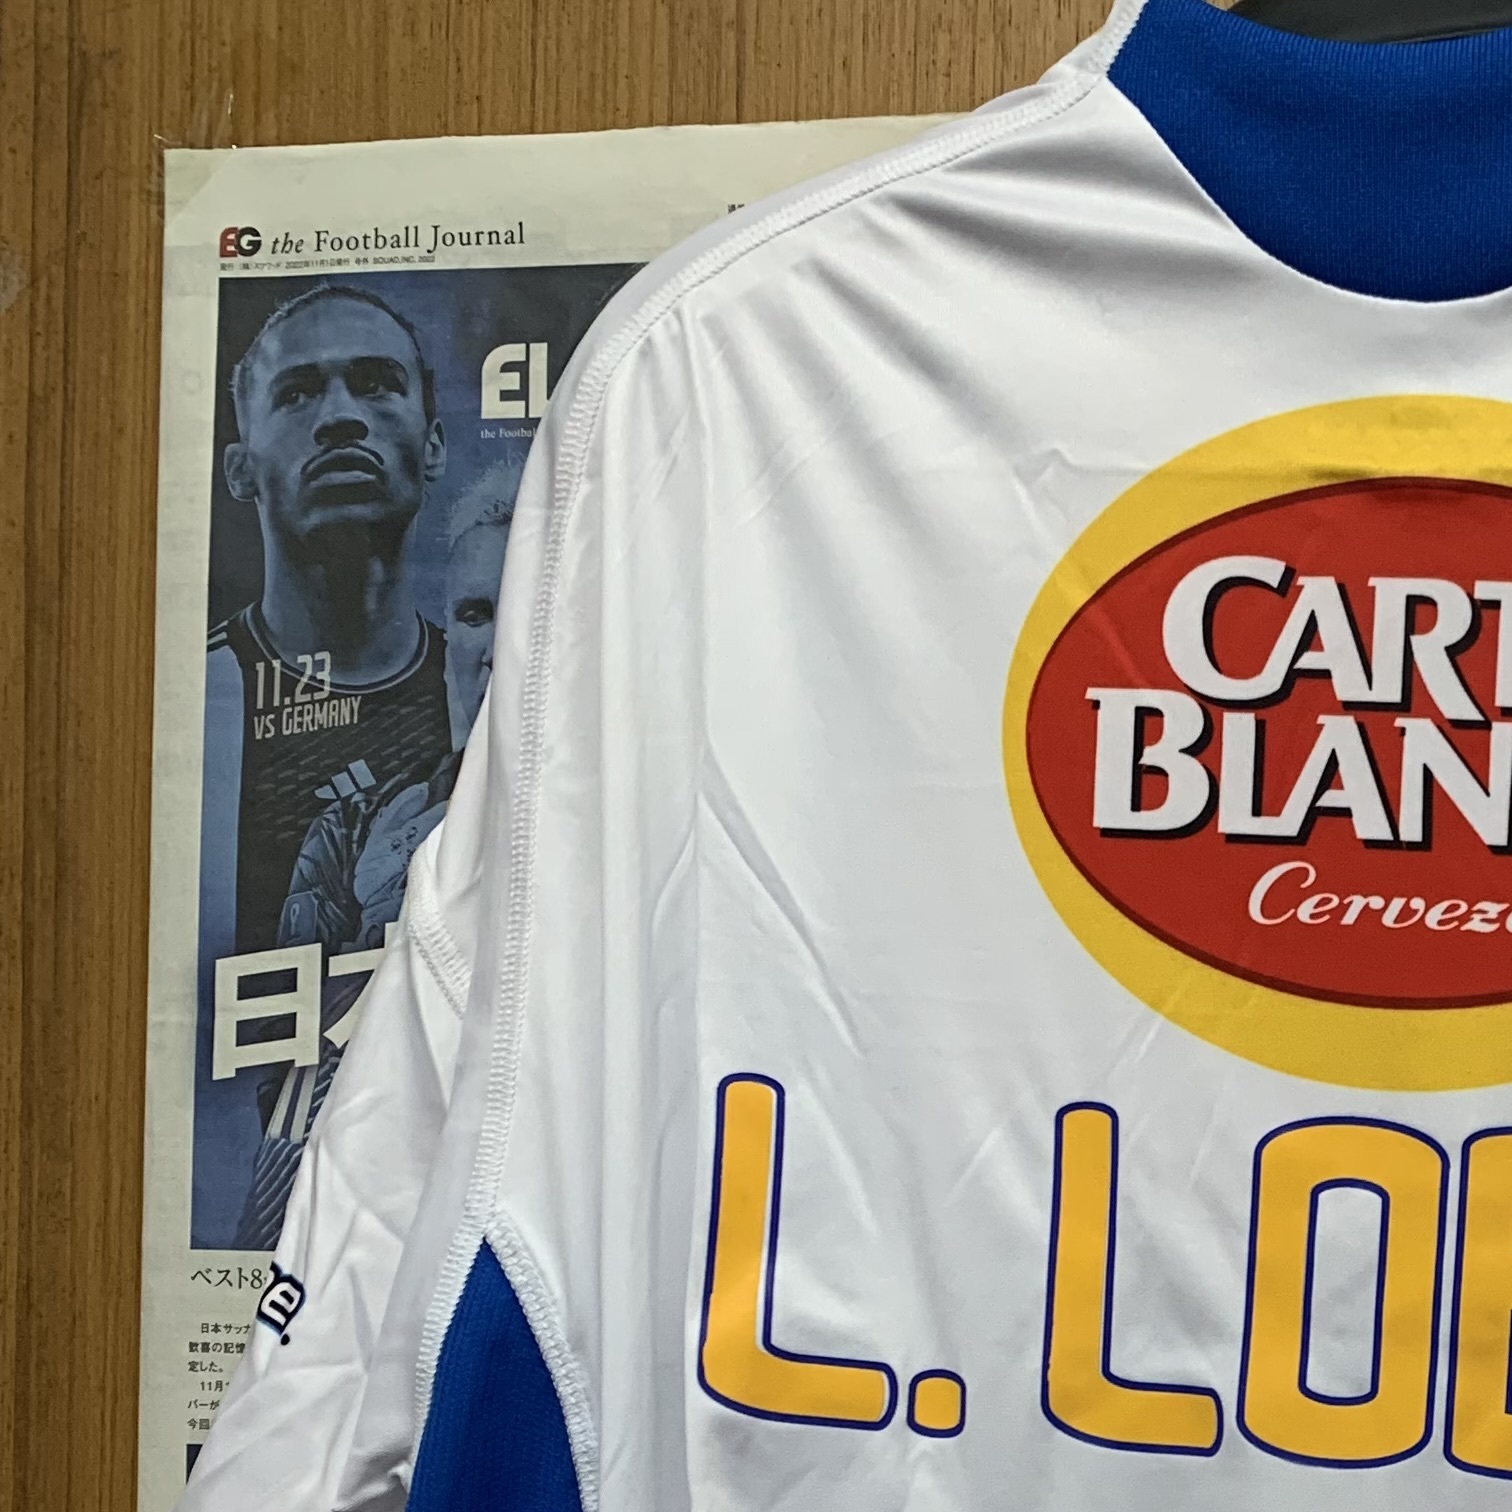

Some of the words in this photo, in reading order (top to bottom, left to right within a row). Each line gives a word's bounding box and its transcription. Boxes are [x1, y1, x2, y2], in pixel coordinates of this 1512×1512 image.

[271, 231, 304, 254] the
[314, 225, 420, 252] Football
[426, 221, 526, 254] Journal
[480, 428, 496, 439] the
[256, 651, 331, 710] 11.23
[254, 714, 276, 740] VS
[282, 696, 362, 736] GERMANY
[698, 1072, 966, 1436] L.
[190, 1266, 267, 1290] ベスト8
[200, 1380, 230, 1392] 11月
